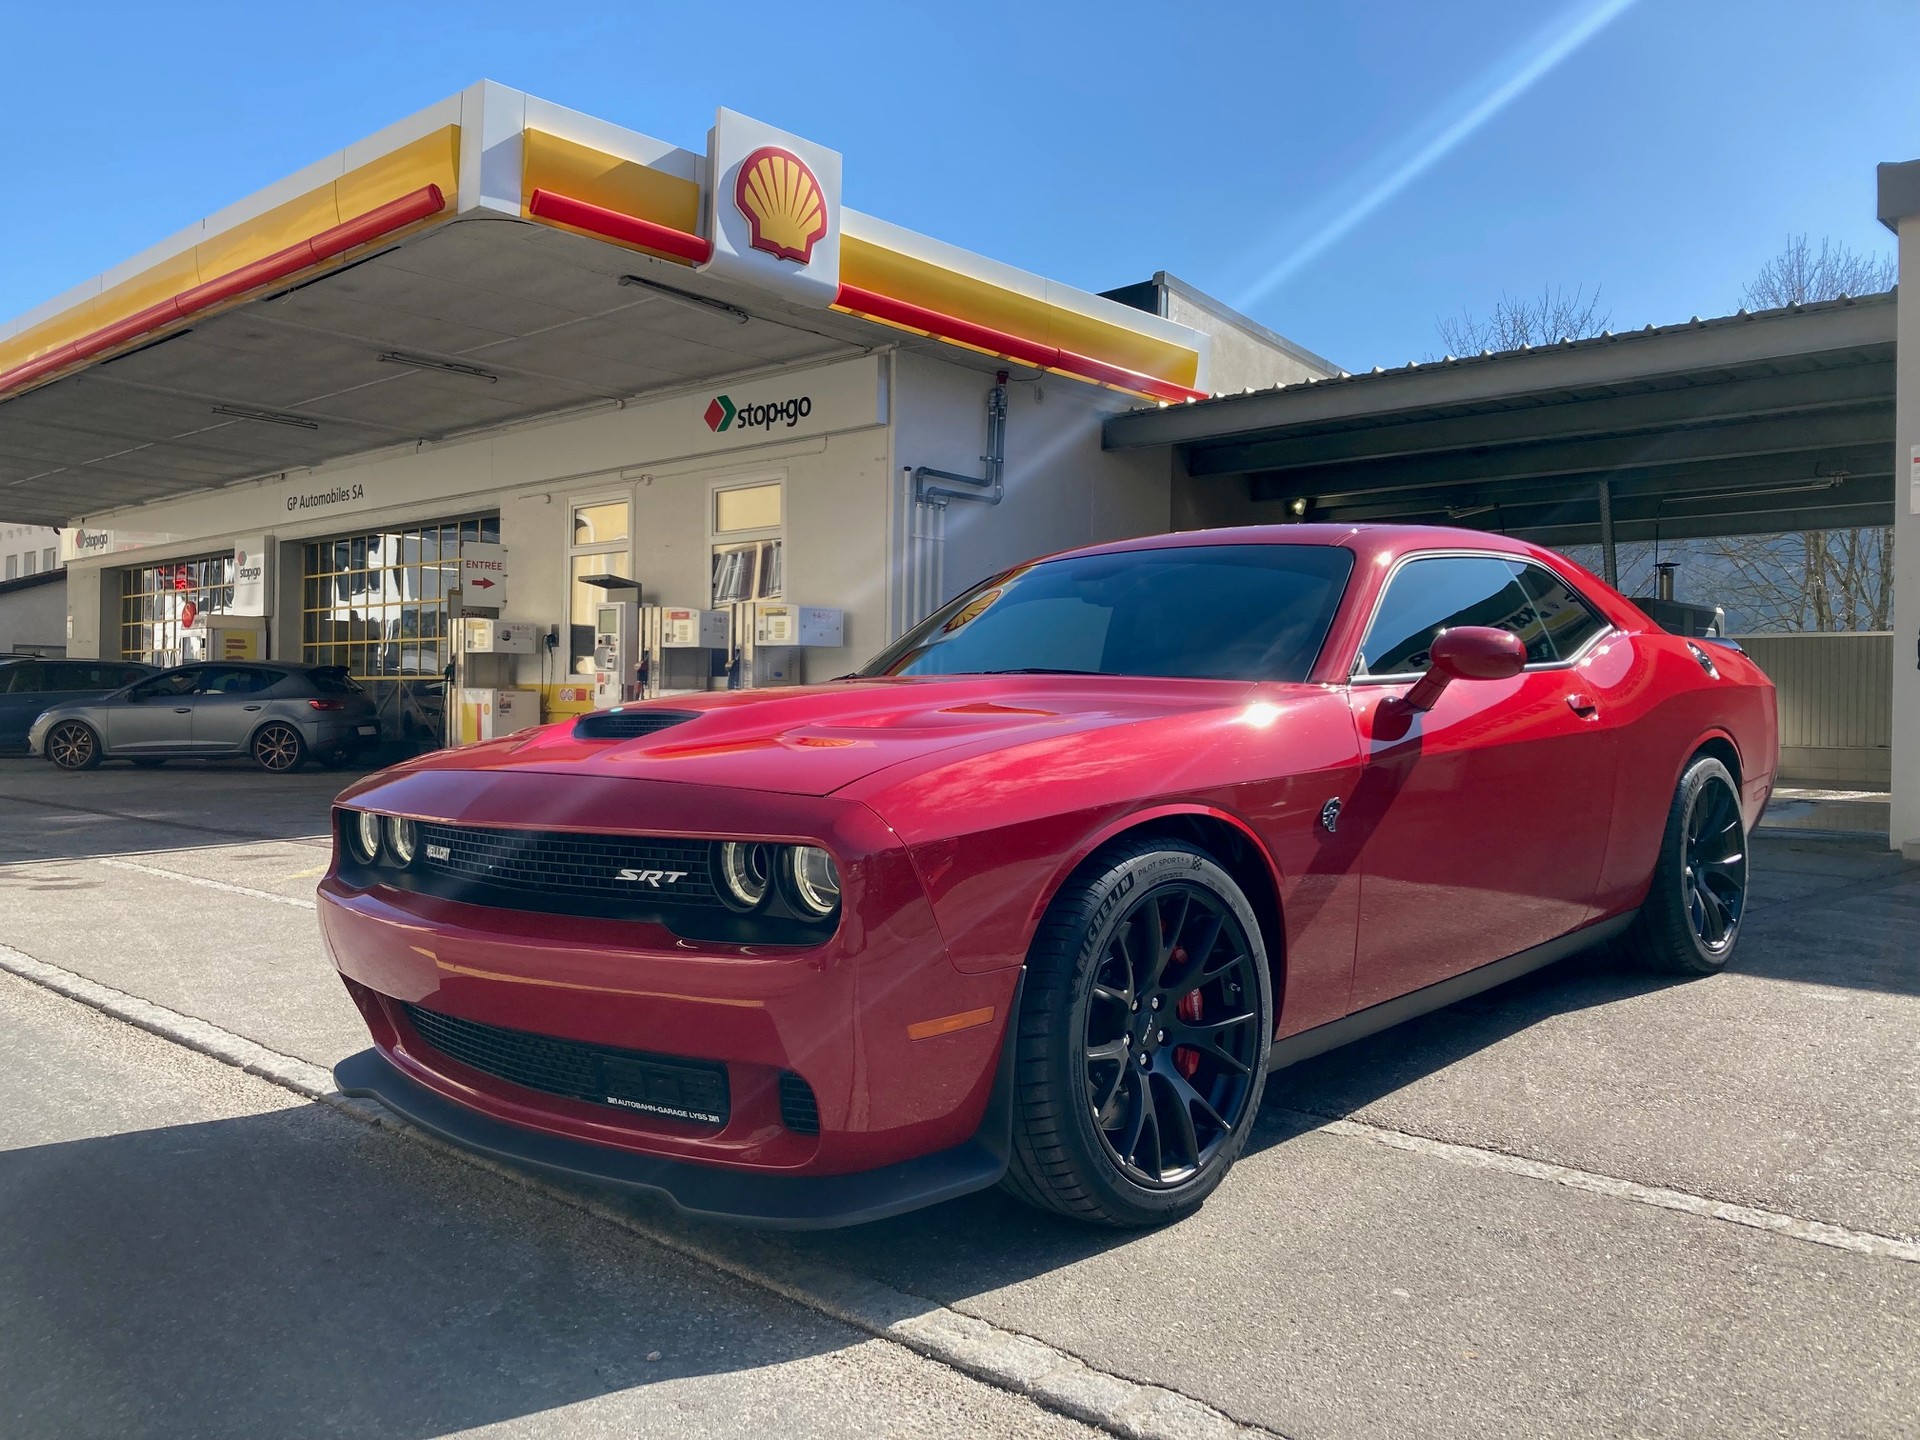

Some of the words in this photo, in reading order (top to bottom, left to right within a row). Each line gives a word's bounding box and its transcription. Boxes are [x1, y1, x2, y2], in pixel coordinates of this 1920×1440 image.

[738, 397, 812, 431] stop+go
[287, 496, 298, 511] GP
[299, 487, 350, 509] Automobiles
[352, 484, 364, 499] SA
[466, 560, 503, 571] ENTRÉE
[1138, 861, 1157, 876] PILOT
[1159, 857, 1180, 867] SPORT
[615, 868, 689, 888] SRT
[1076, 874, 1132, 972] MICHELIN
[618, 1099, 688, 1117] AUTOBAHN-GARAGE
[689, 1111, 708, 1121] LYSS
